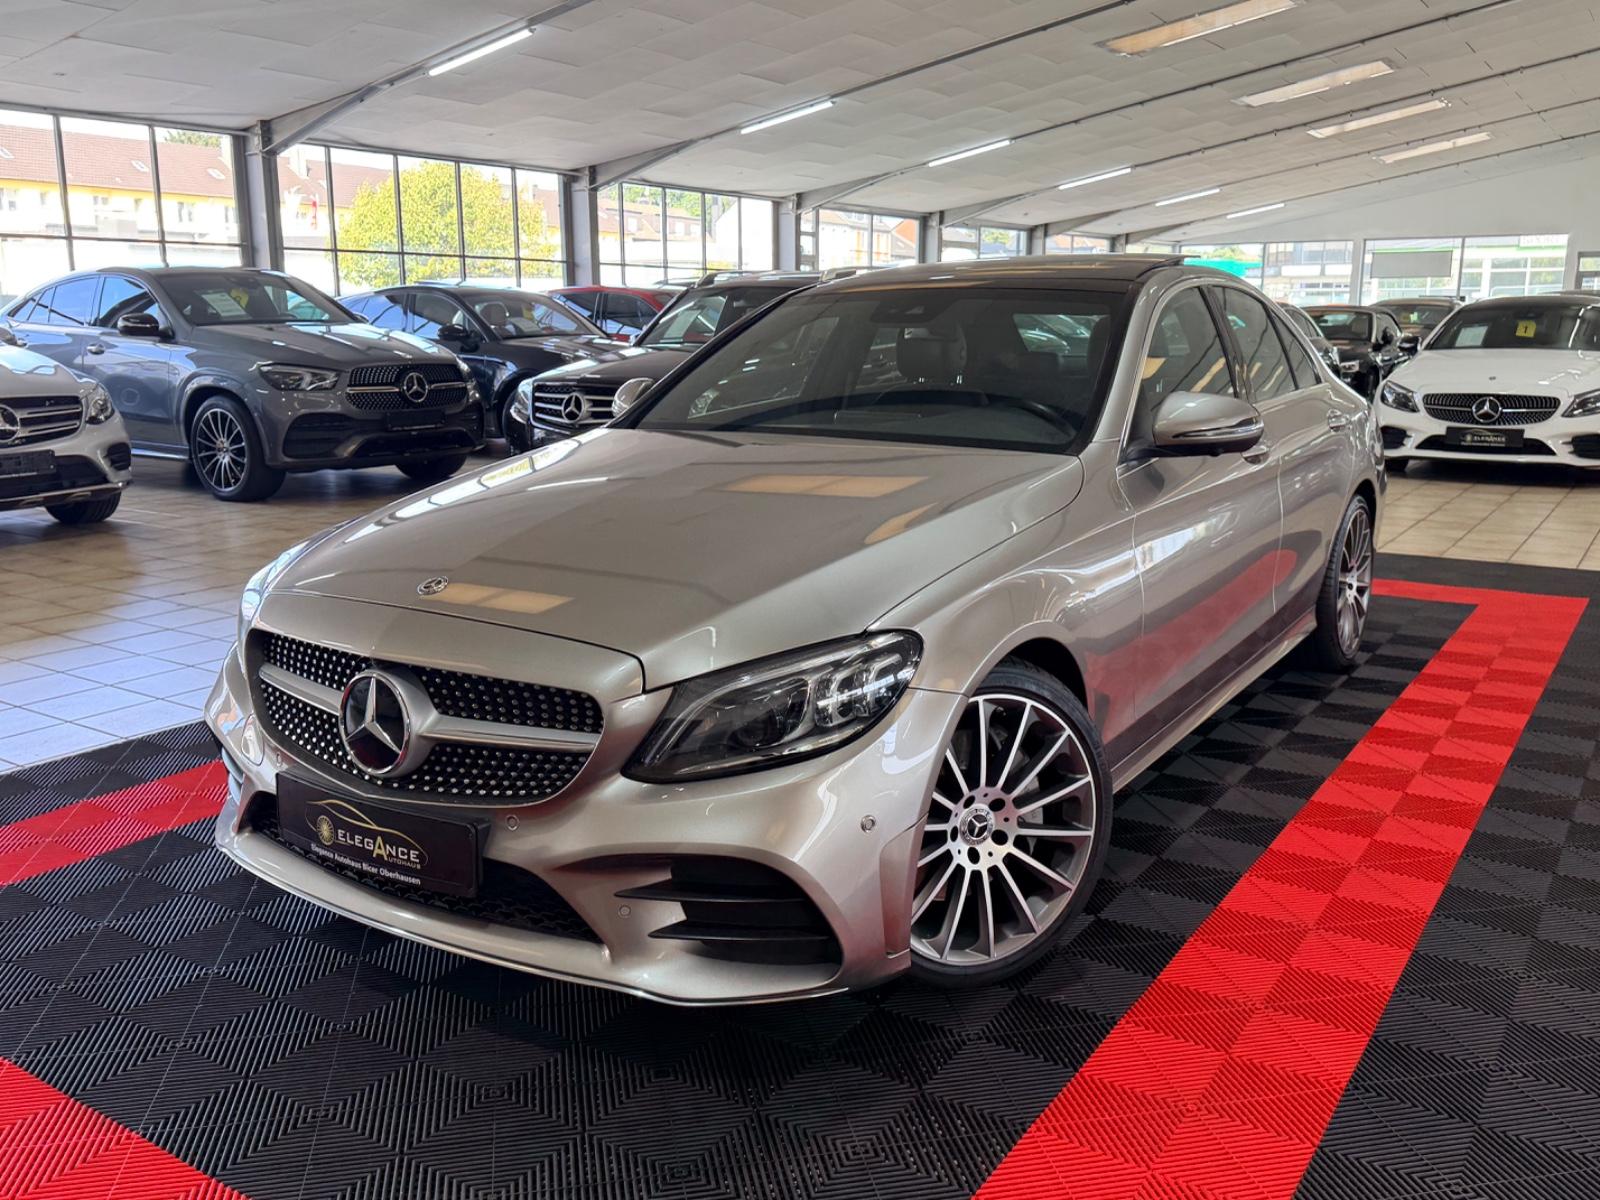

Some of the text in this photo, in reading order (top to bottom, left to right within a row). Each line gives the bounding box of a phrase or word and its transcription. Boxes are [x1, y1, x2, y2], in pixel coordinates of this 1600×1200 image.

[311, 843, 334, 859] Elegance
[334, 853, 362, 870] Autohaus
[379, 868, 421, 885] Oberhausen
[337, 829, 420, 863] ELEGANCE
